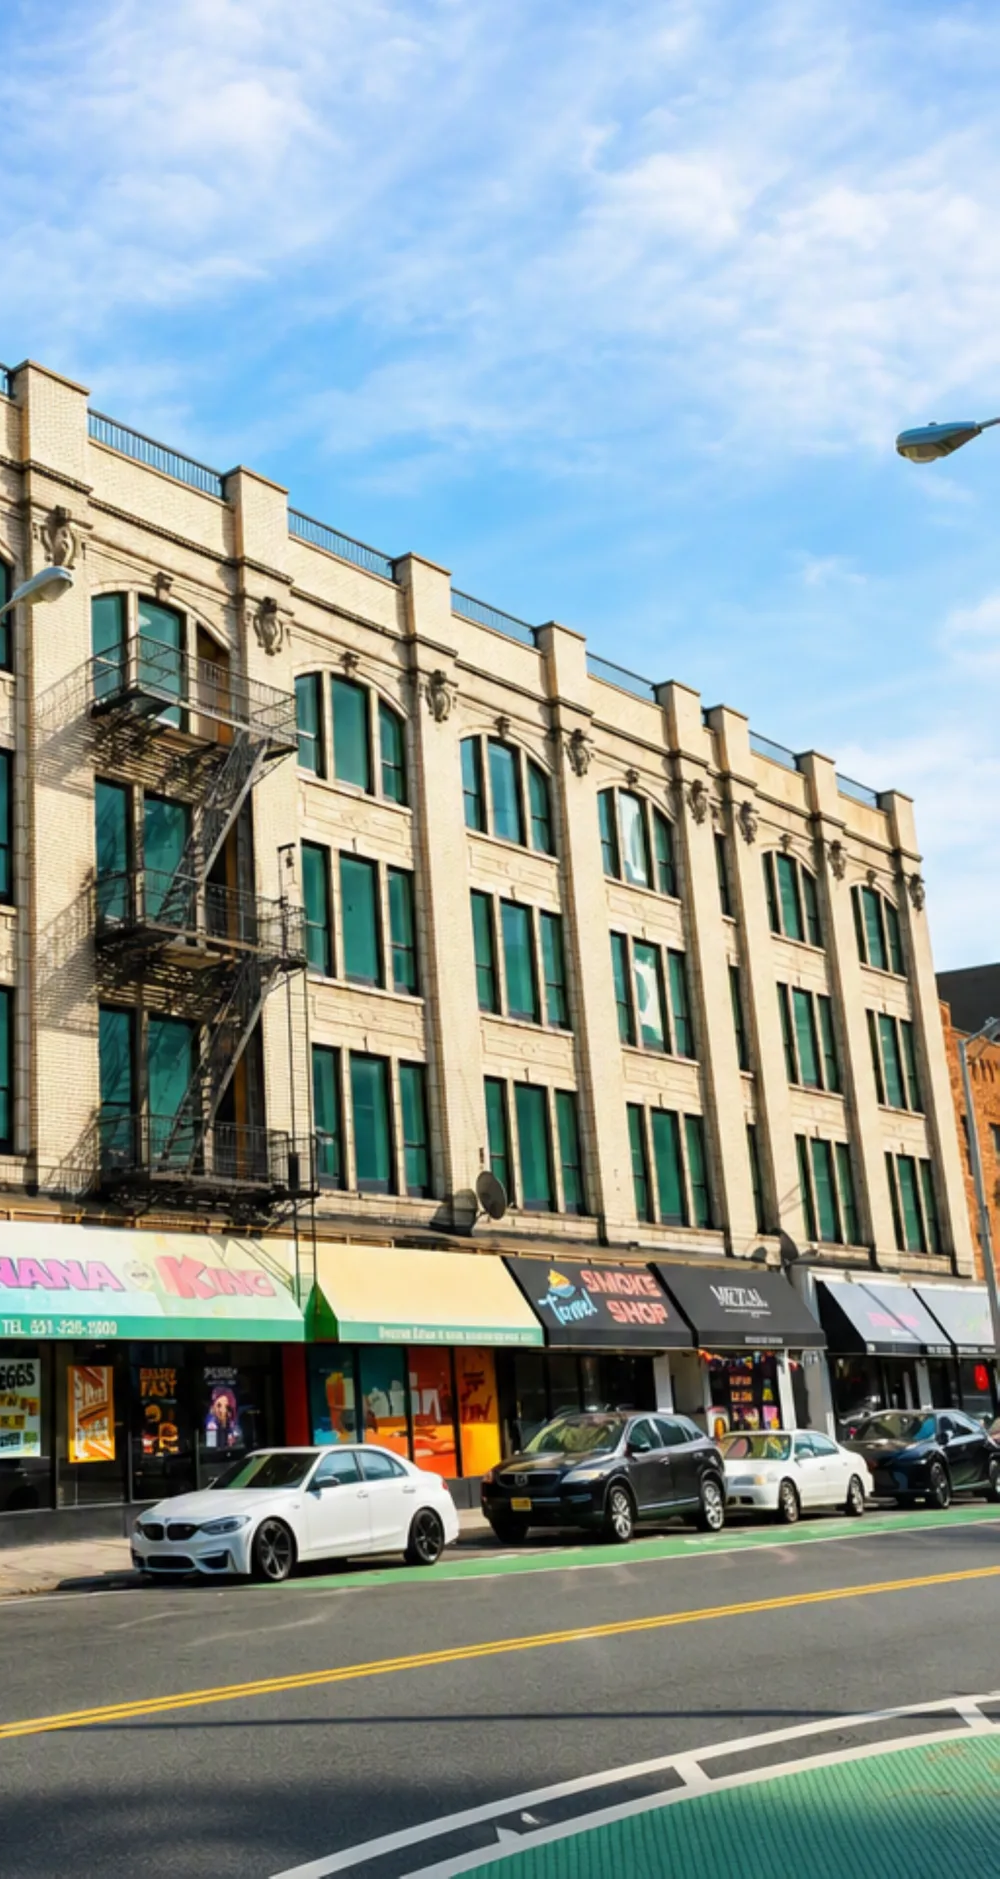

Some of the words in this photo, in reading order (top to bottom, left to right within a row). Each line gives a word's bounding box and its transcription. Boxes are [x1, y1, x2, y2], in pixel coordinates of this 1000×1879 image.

[155, 1254, 277, 1299] KING
[580, 1269, 662, 1298] SMOKE
[606, 1299, 669, 1325] SHOP
[1, 1319, 27, 1334] TEL
